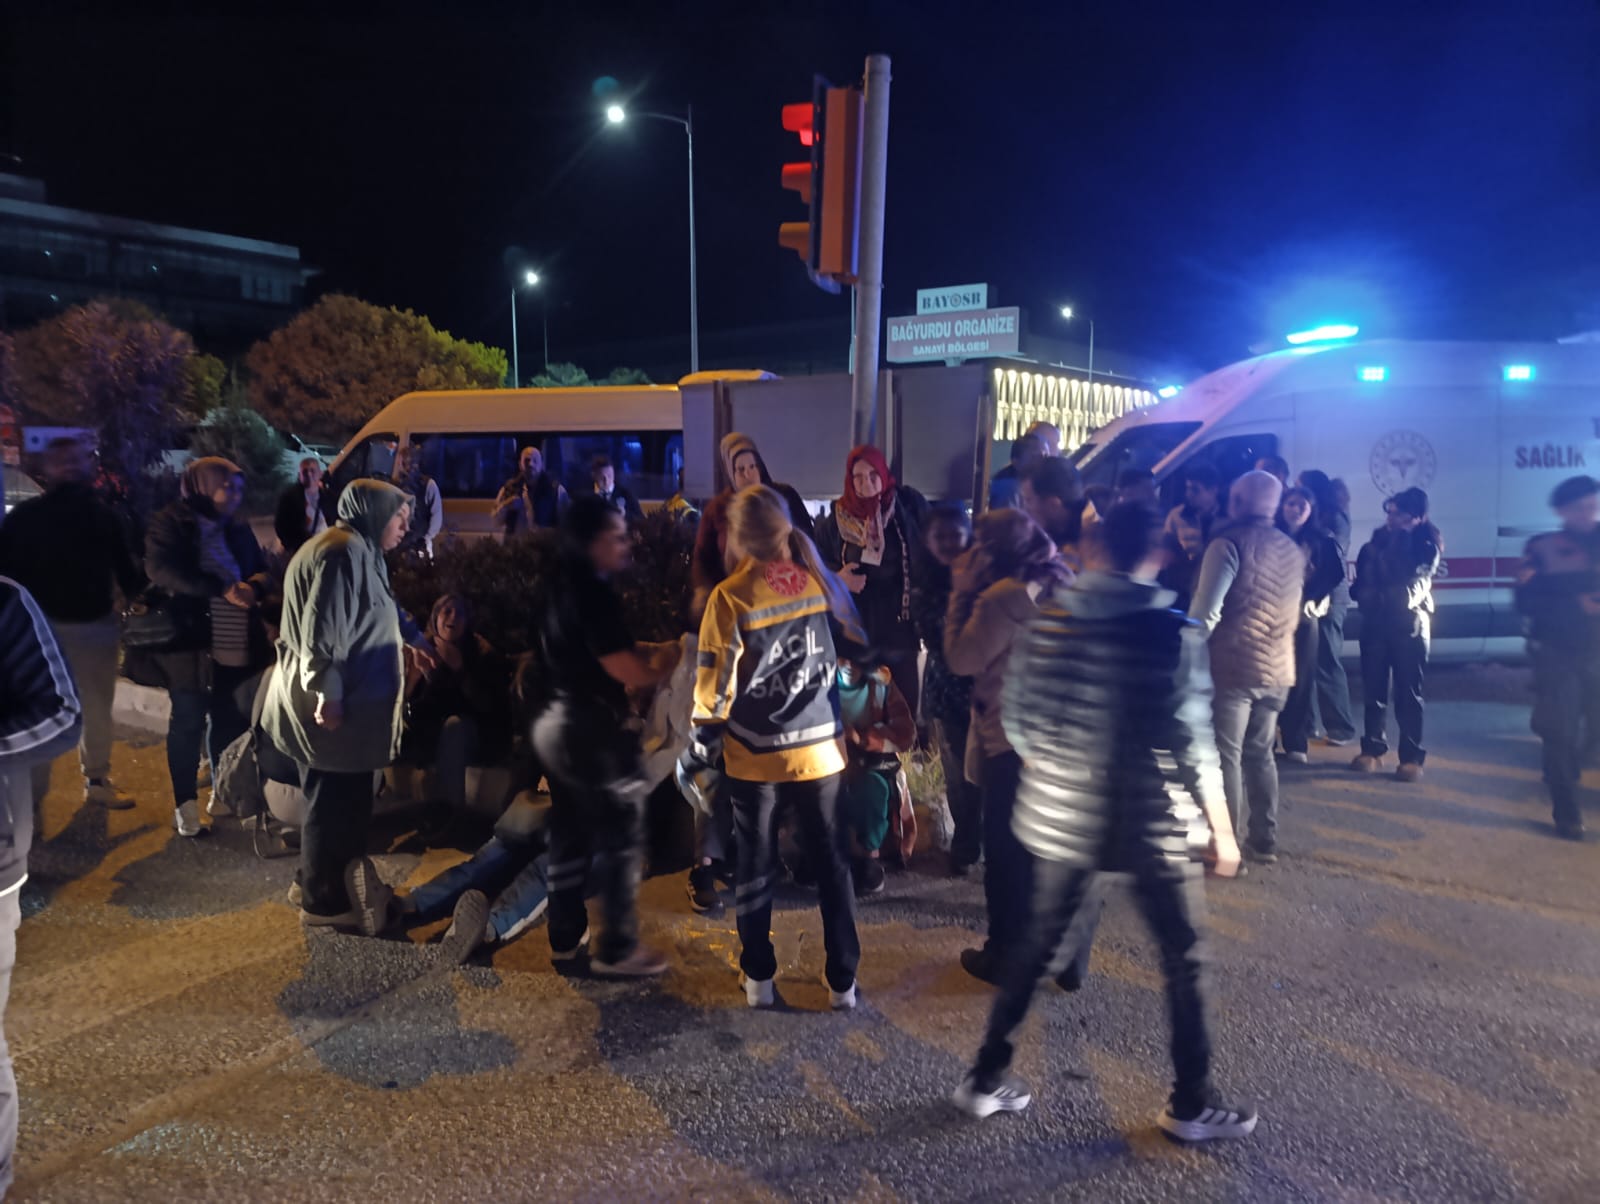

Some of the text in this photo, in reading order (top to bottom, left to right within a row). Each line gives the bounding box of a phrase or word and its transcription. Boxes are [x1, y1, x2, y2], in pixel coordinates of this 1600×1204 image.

[922, 292, 981, 310] BAYOSB
[891, 313, 1015, 342] BAĞYURDU ORGANİZE
[913, 339, 990, 356] SANAYİ BÖLGESİ
